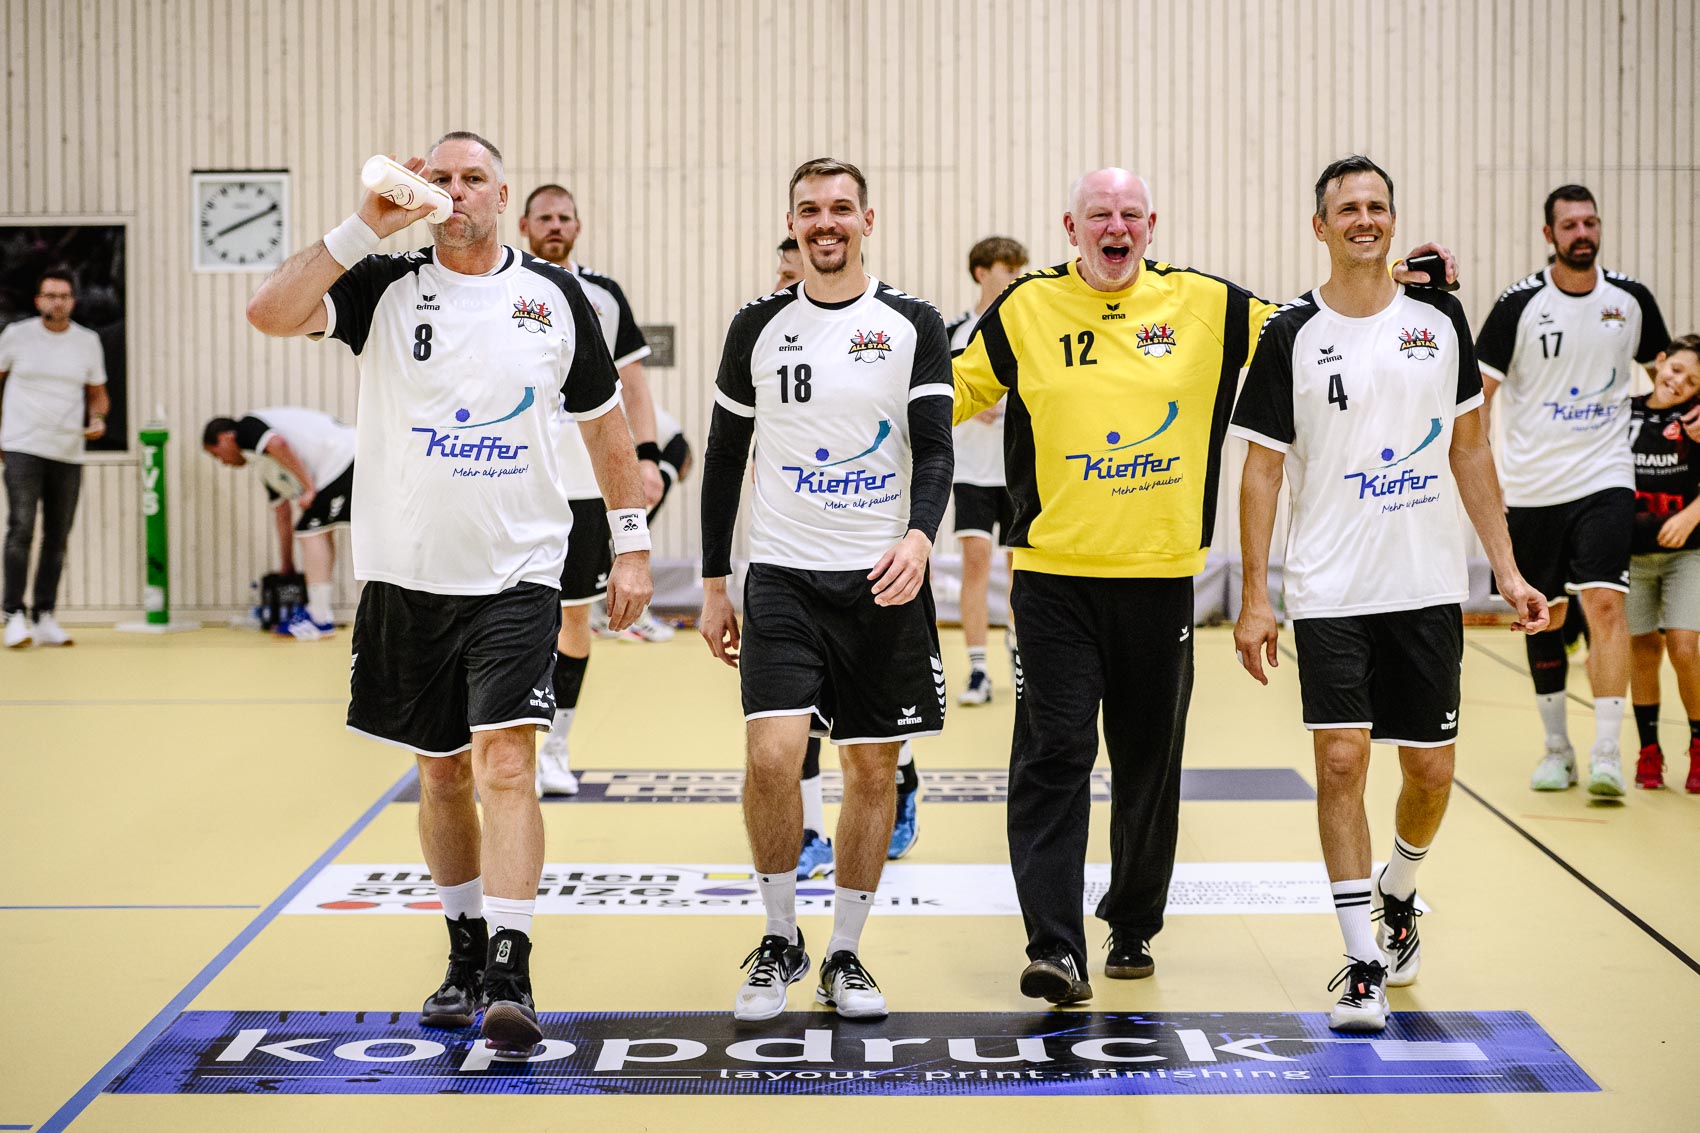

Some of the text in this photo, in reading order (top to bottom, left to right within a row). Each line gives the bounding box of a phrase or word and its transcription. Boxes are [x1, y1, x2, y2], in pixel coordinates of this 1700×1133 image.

[416, 303, 440, 311] erima
[530, 312, 550, 324] STAR
[413, 323, 433, 361] 8
[1138, 338, 1153, 347] ALL
[1402, 340, 1436, 349] ALL STAR
[1539, 331, 1563, 359] 17
[779, 344, 803, 352] erima
[850, 344, 866, 352] ALL
[1059, 330, 1097, 367] 12
[1317, 354, 1343, 365] erima
[777, 363, 812, 403] 18
[1328, 373, 1348, 411] 4
[412, 427, 528, 461] Kieffer
[1635, 453, 1679, 467] RAUN
[452, 467, 480, 477] Mehr
[1065, 453, 1180, 480] Kieffer
[782, 466, 896, 495] Kieffer
[1112, 486, 1137, 496] Mehr
[824, 501, 849, 510] Mehr
[897, 716, 922, 725] erima
[364, 872, 680, 882] thten
[347, 885, 675, 896] sclze
[577, 897, 944, 907] augenik
[215, 1028, 1300, 1072] koppdruck
[719, 1068, 1311, 1081] layout print finishing
